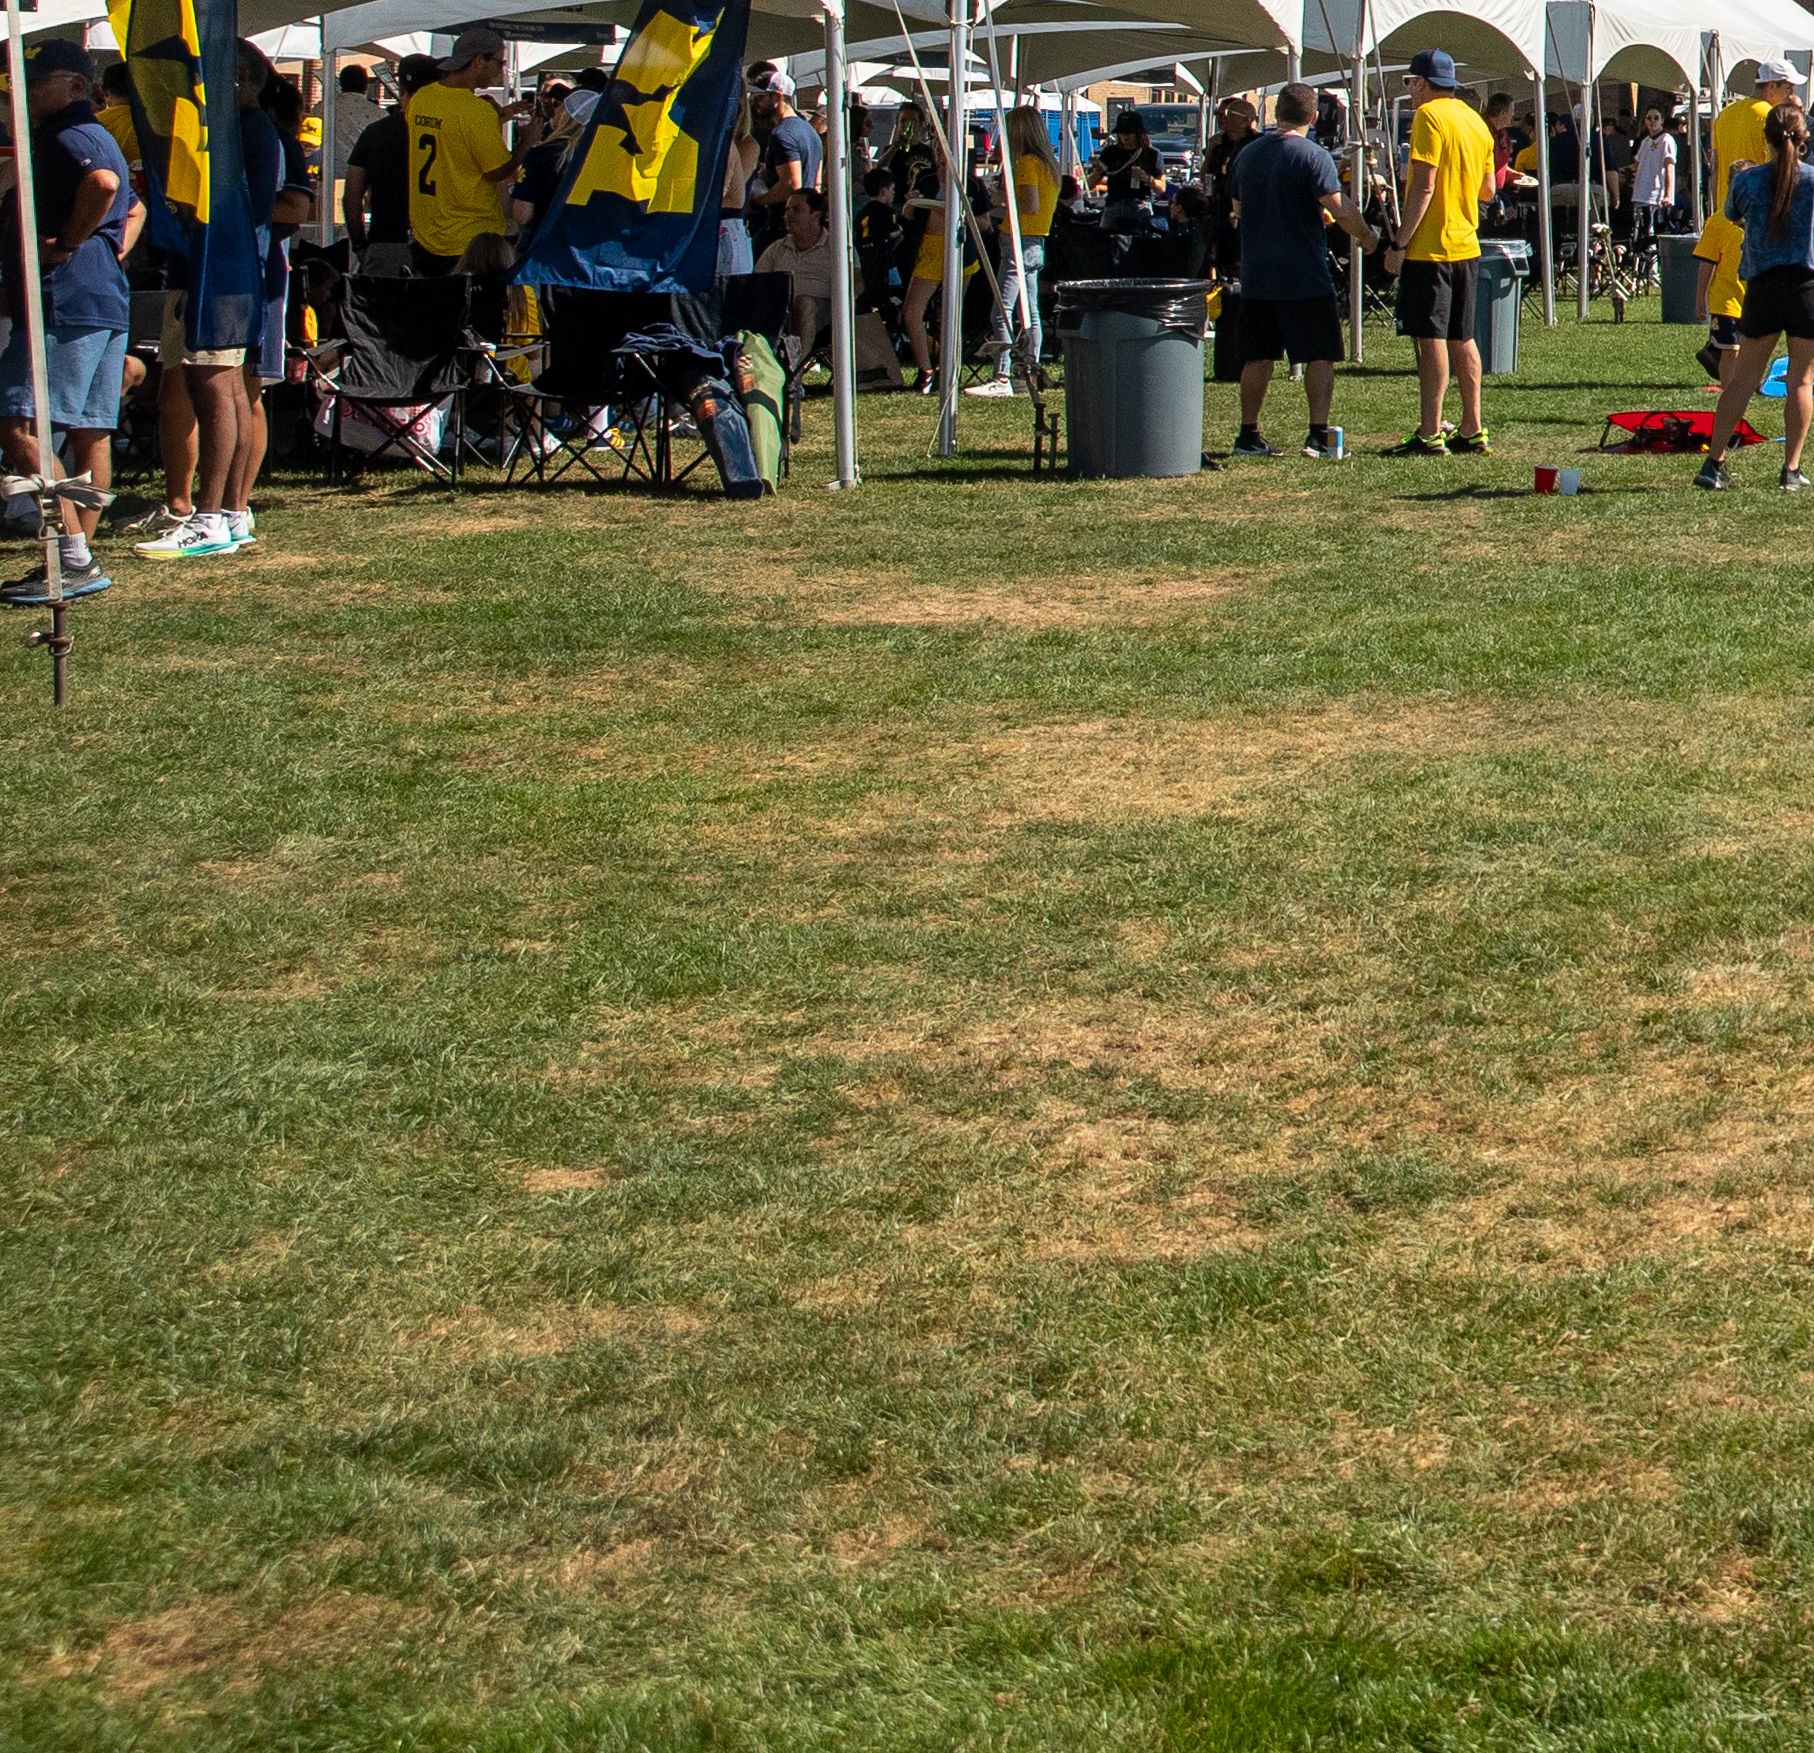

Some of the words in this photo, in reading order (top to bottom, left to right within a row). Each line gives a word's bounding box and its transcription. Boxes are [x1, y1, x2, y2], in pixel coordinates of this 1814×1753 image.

[415, 114, 443, 129] CORUM
[418, 133, 437, 197] 2
[177, 530, 209, 549] HOKA
